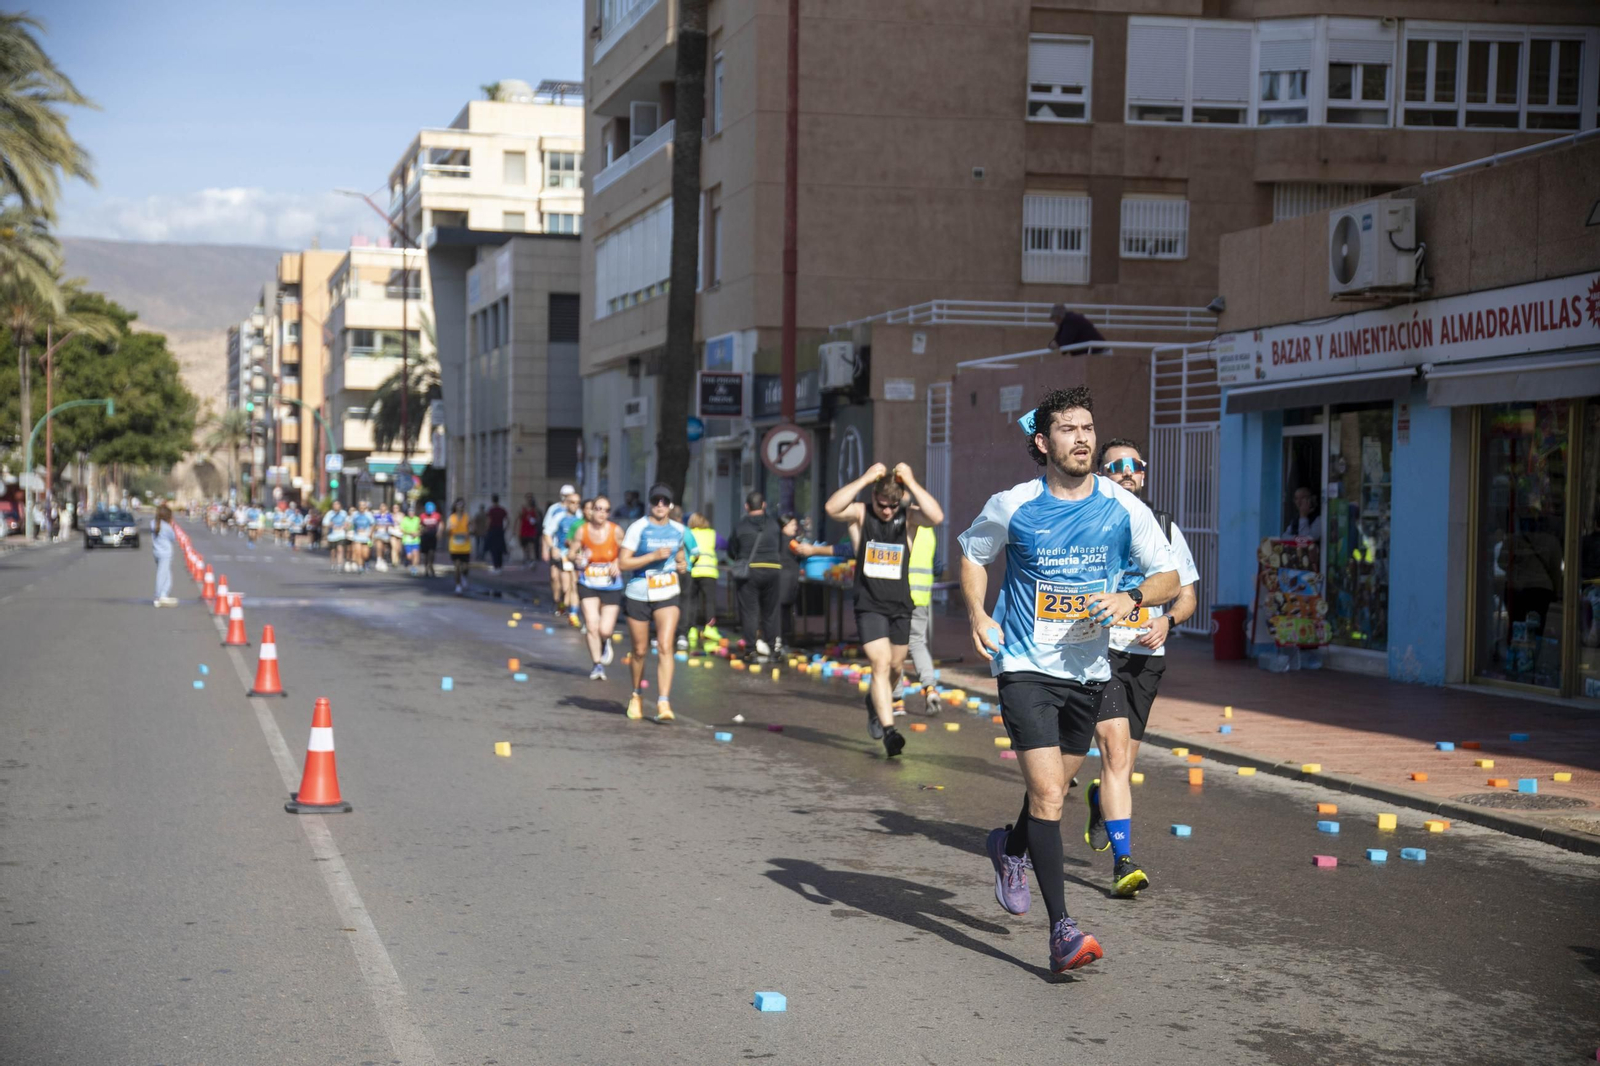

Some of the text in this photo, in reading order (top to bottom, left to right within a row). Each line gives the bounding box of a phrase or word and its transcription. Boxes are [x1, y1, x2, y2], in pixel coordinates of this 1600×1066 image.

[1272, 336, 1312, 366] BAZAR
[1315, 334, 1324, 358] Y
[1329, 310, 1434, 359] ALIMENTACIÓN
[1440, 294, 1583, 345] ALMADRAVILLAS
[871, 549, 898, 562] 1818
[1036, 544, 1109, 556] Medio Maratón
[1036, 552, 1107, 567] Almería 2025
[1038, 568, 1061, 576] AMÓN
[1044, 594, 1092, 613] 253
